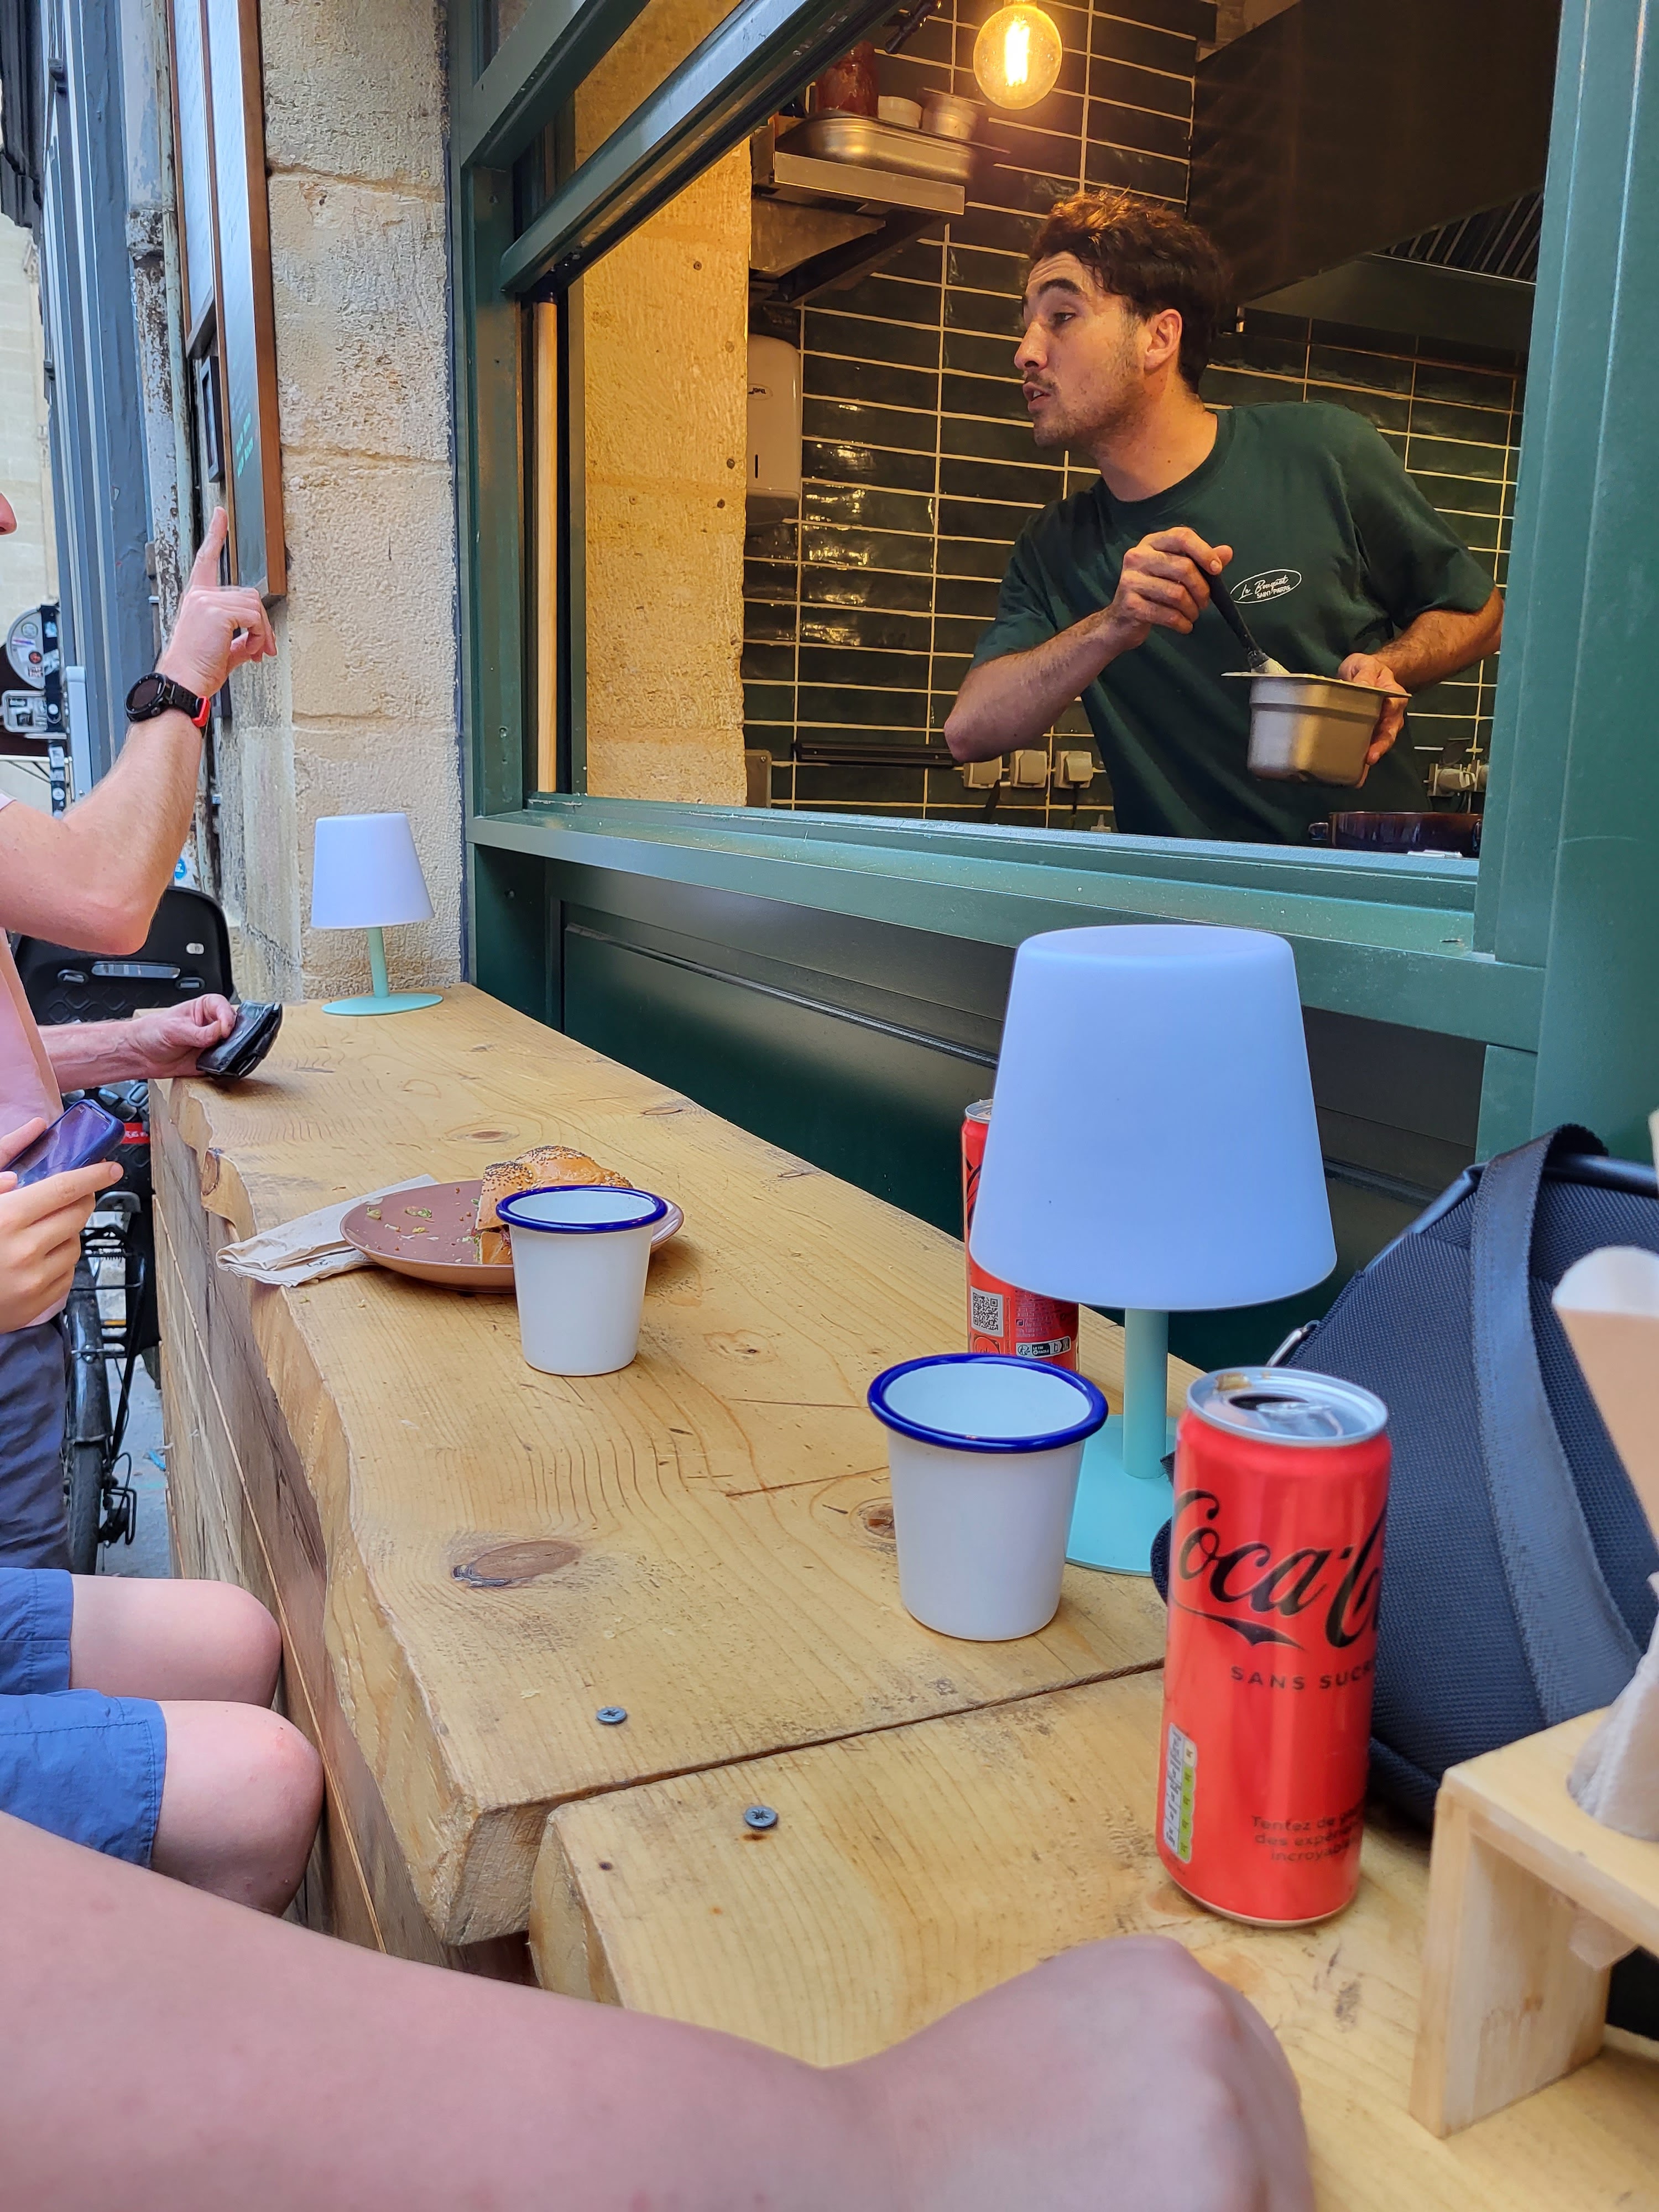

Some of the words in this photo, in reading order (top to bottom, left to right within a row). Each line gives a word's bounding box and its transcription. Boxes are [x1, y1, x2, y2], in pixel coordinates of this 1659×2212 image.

[1230, 1666, 1305, 1691] SANS
[1318, 1658, 1374, 1690] SUCR
[1254, 1833, 1288, 1846] des
